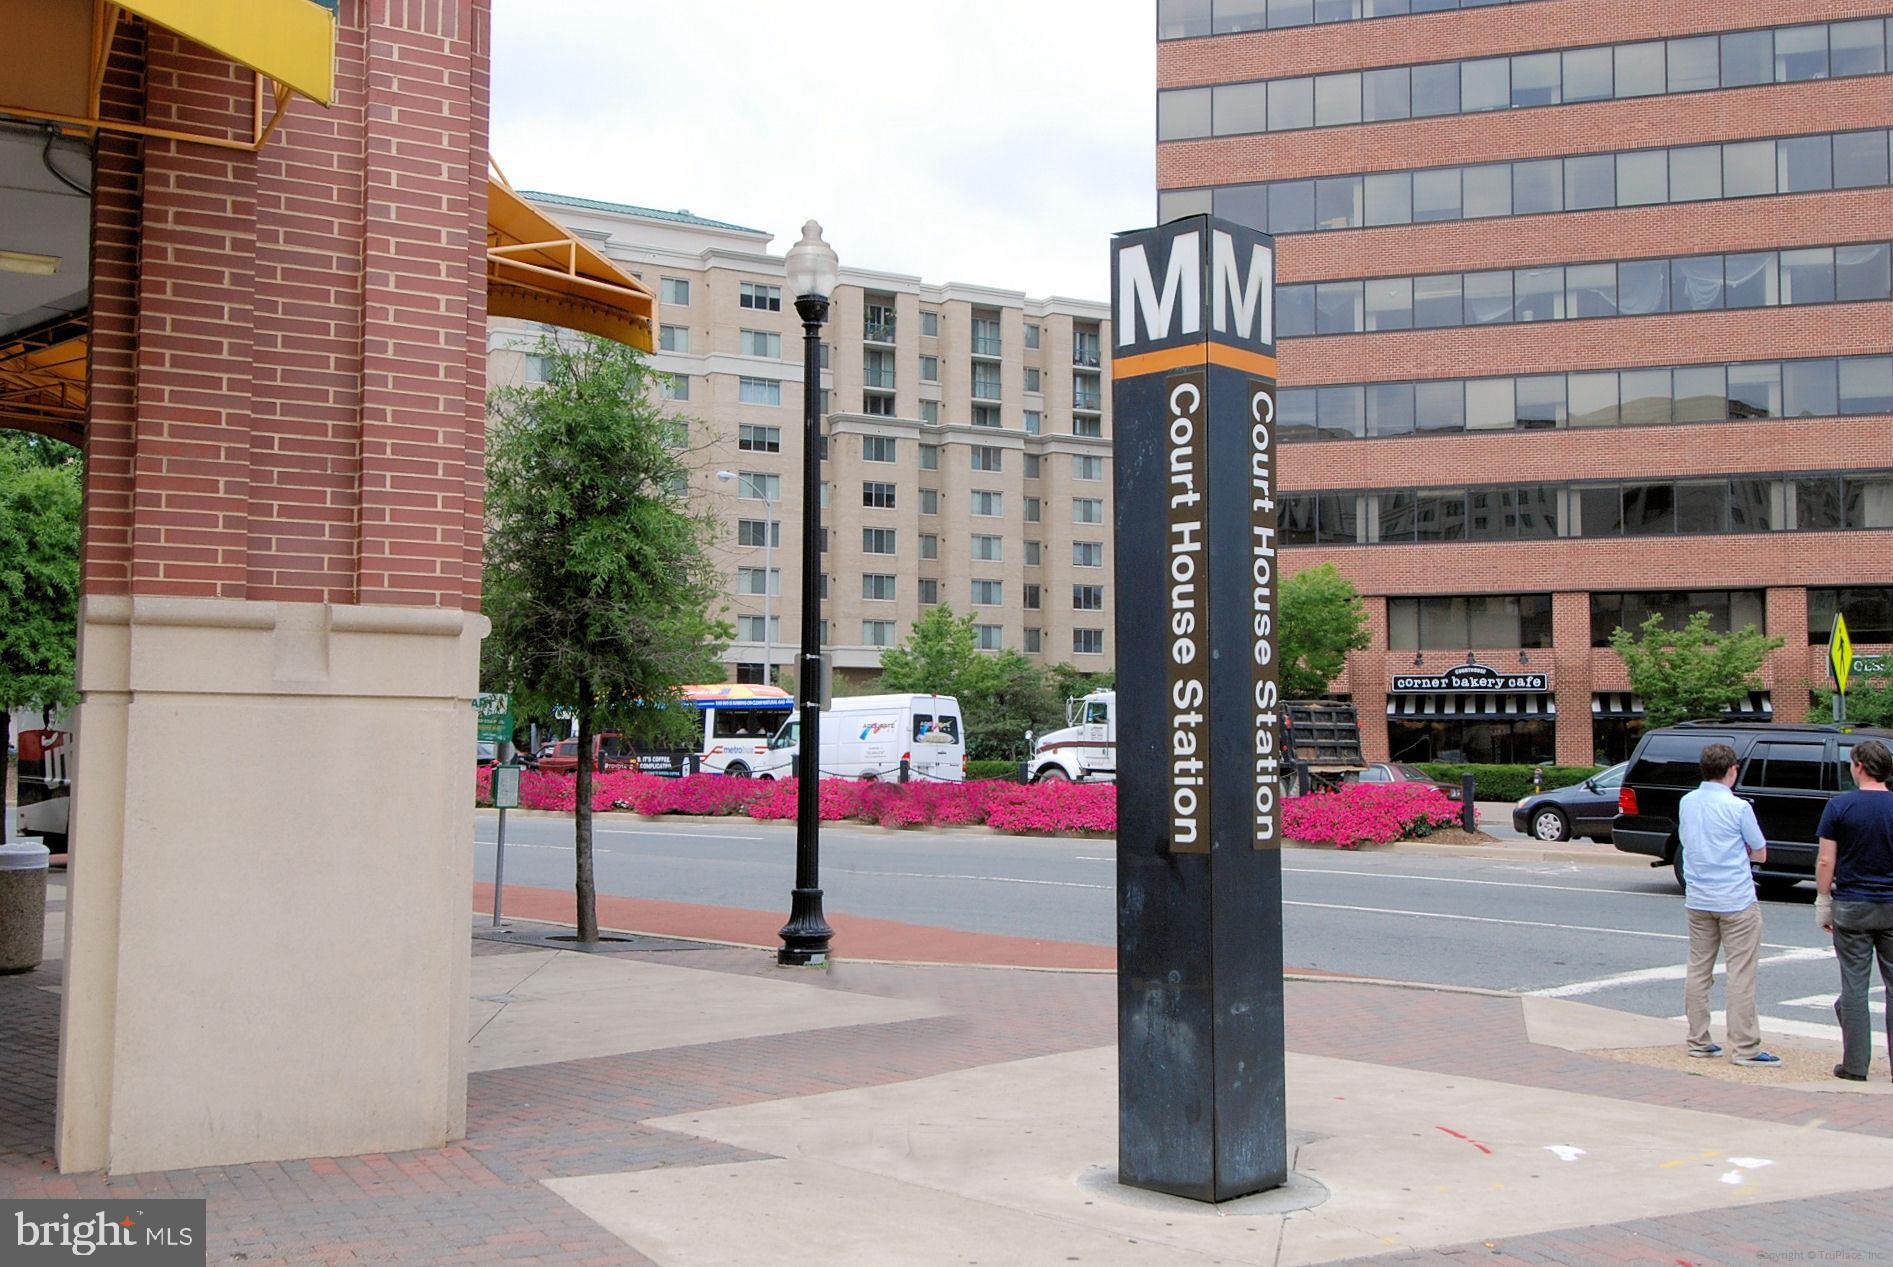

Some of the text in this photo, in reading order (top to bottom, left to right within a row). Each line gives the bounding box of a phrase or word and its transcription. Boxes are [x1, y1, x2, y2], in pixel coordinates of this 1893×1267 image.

[1119, 230, 1201, 347] M
[1212, 229, 1273, 346] M
[1170, 382, 1204, 844] Court House Station
[1251, 391, 1278, 841] Court House Station
[1397, 675, 1542, 689] corner bakery cafe
